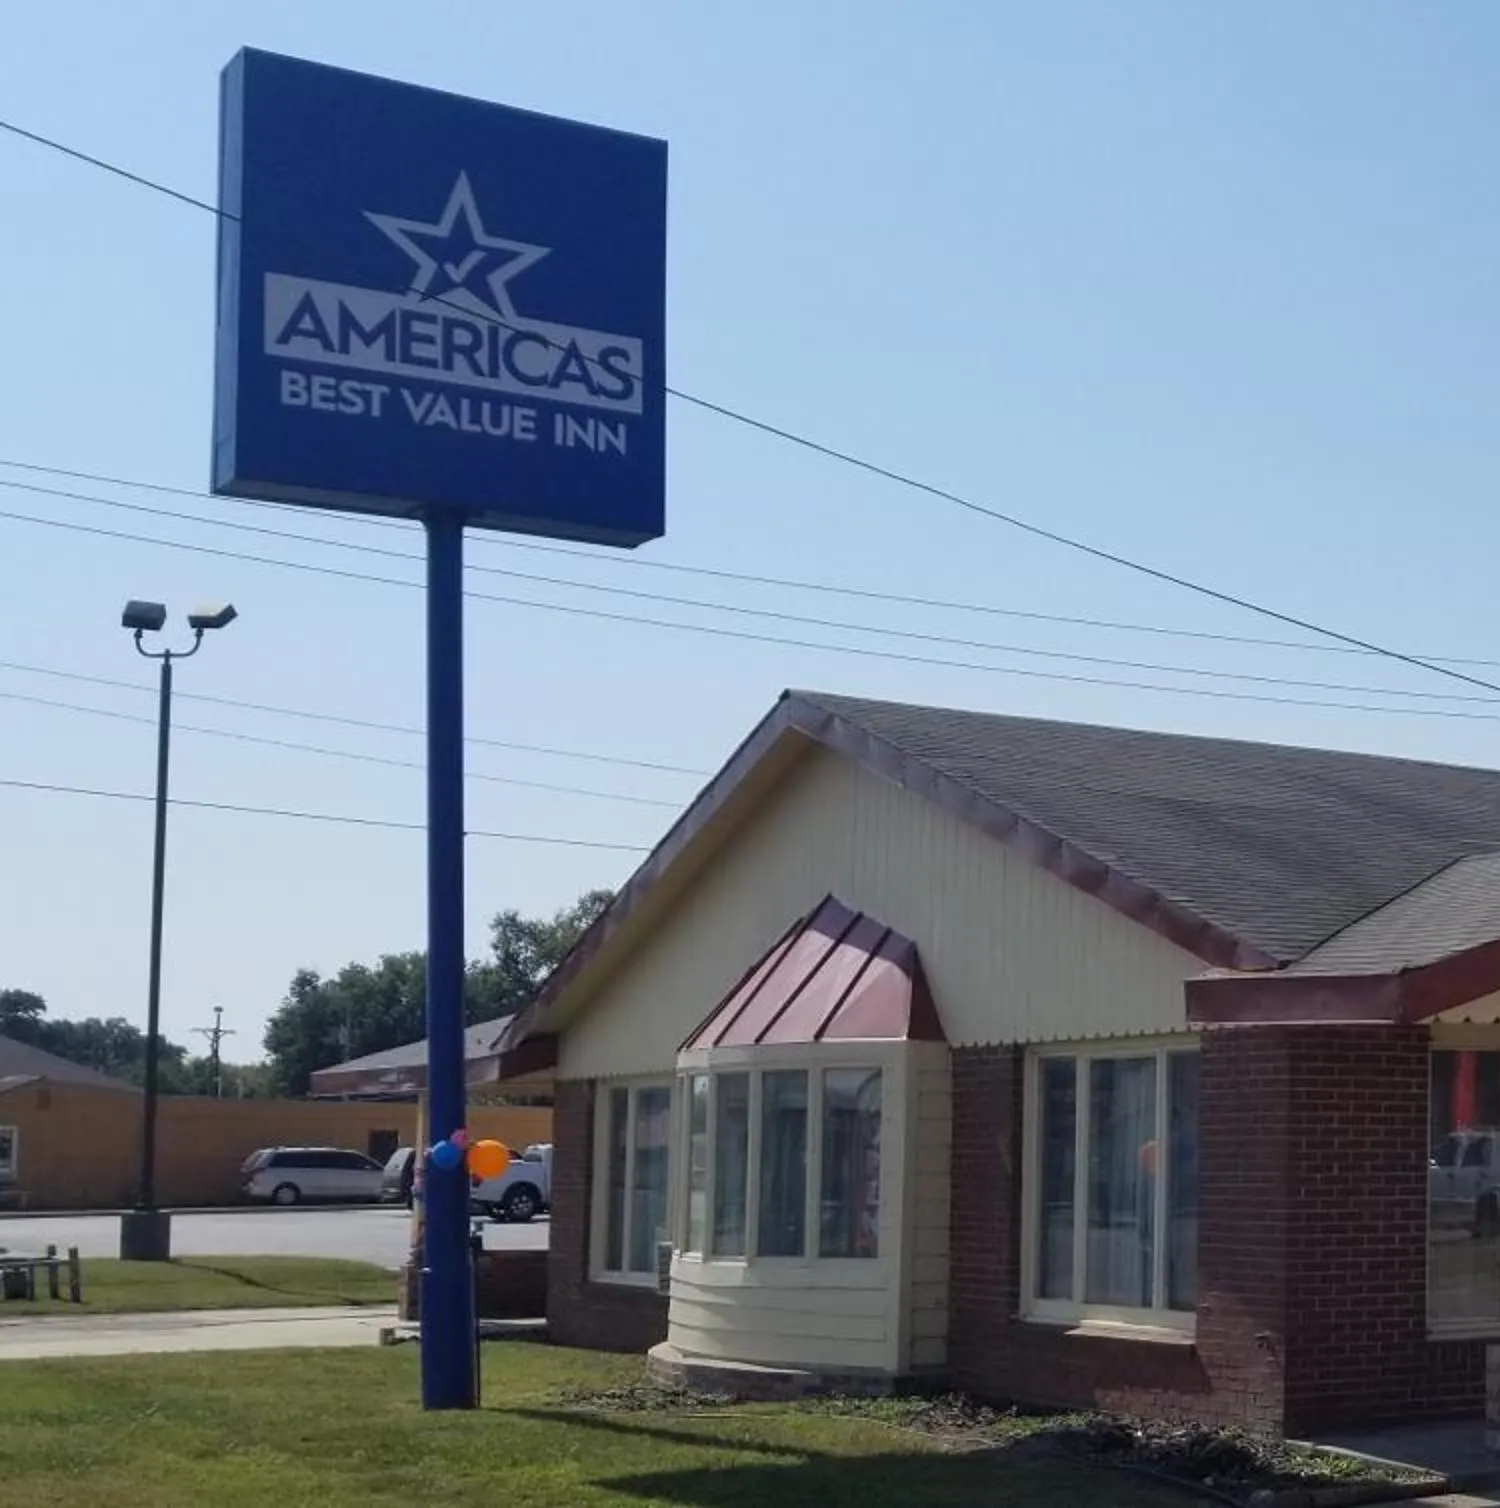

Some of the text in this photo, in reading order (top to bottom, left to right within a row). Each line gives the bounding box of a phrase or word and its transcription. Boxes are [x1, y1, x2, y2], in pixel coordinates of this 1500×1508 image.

[275, 290, 635, 400] AMERICAS
[281, 370, 626, 456] BEST VALUE INN
